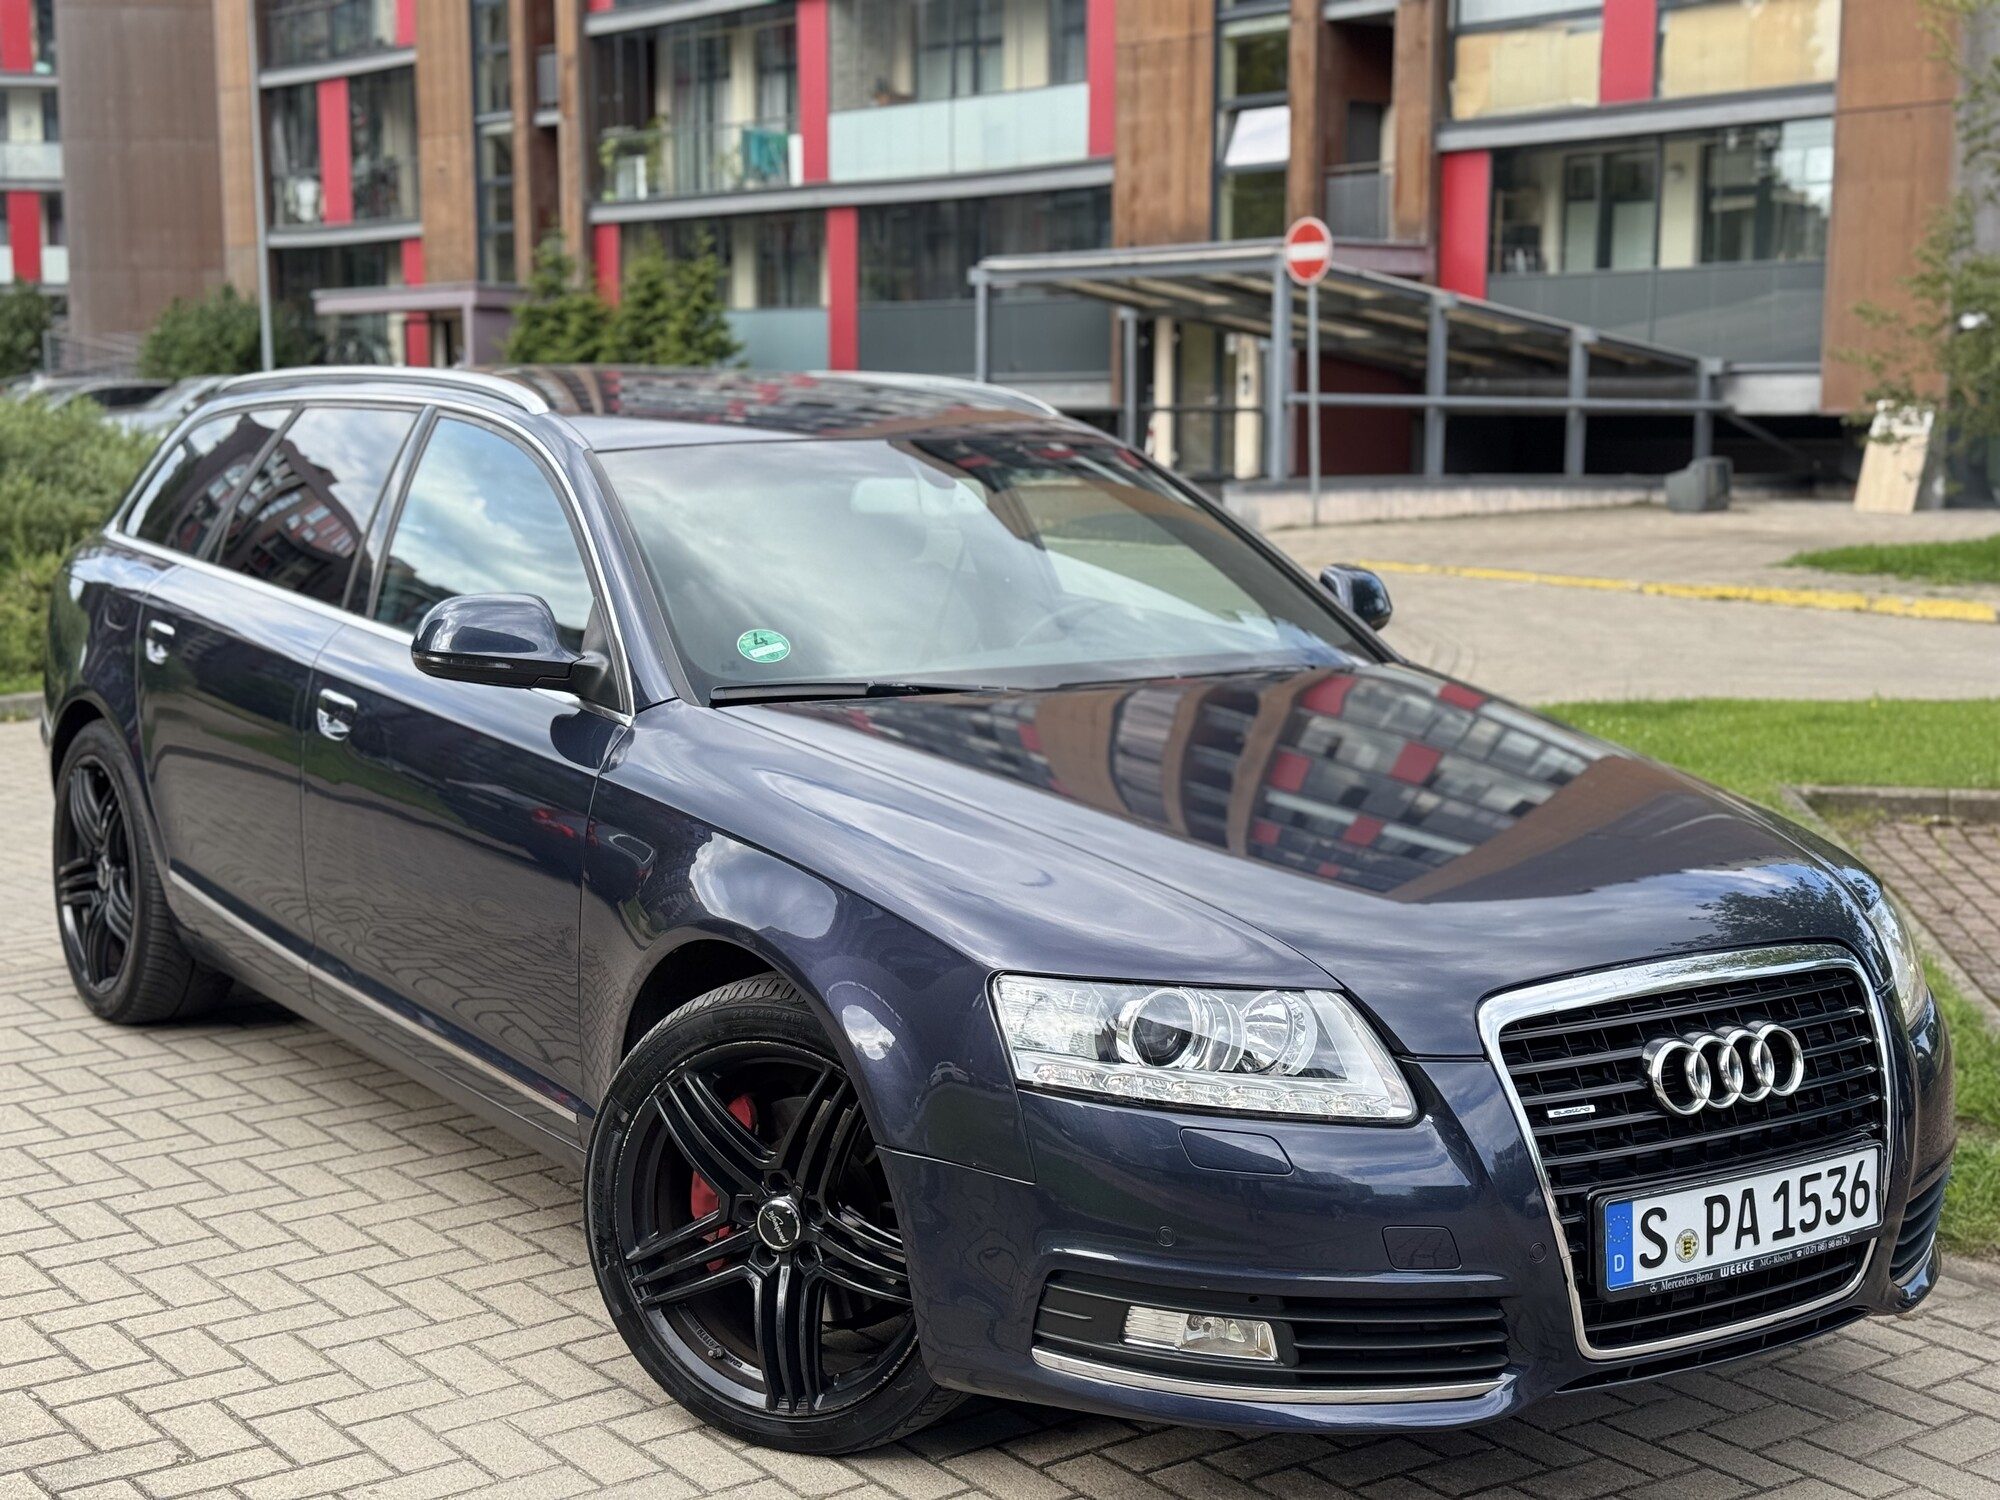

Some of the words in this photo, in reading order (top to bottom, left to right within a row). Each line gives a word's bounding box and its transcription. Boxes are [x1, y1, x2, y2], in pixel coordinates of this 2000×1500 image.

[1639, 1207, 1668, 1269] S
[1704, 1187, 1761, 1256] PA
[1772, 1160, 1870, 1241] 1536
[1613, 1254, 1625, 1273] D
[1660, 1271, 1714, 1292] Mercedes-Benz
[1720, 1261, 1754, 1277] WEEKE
